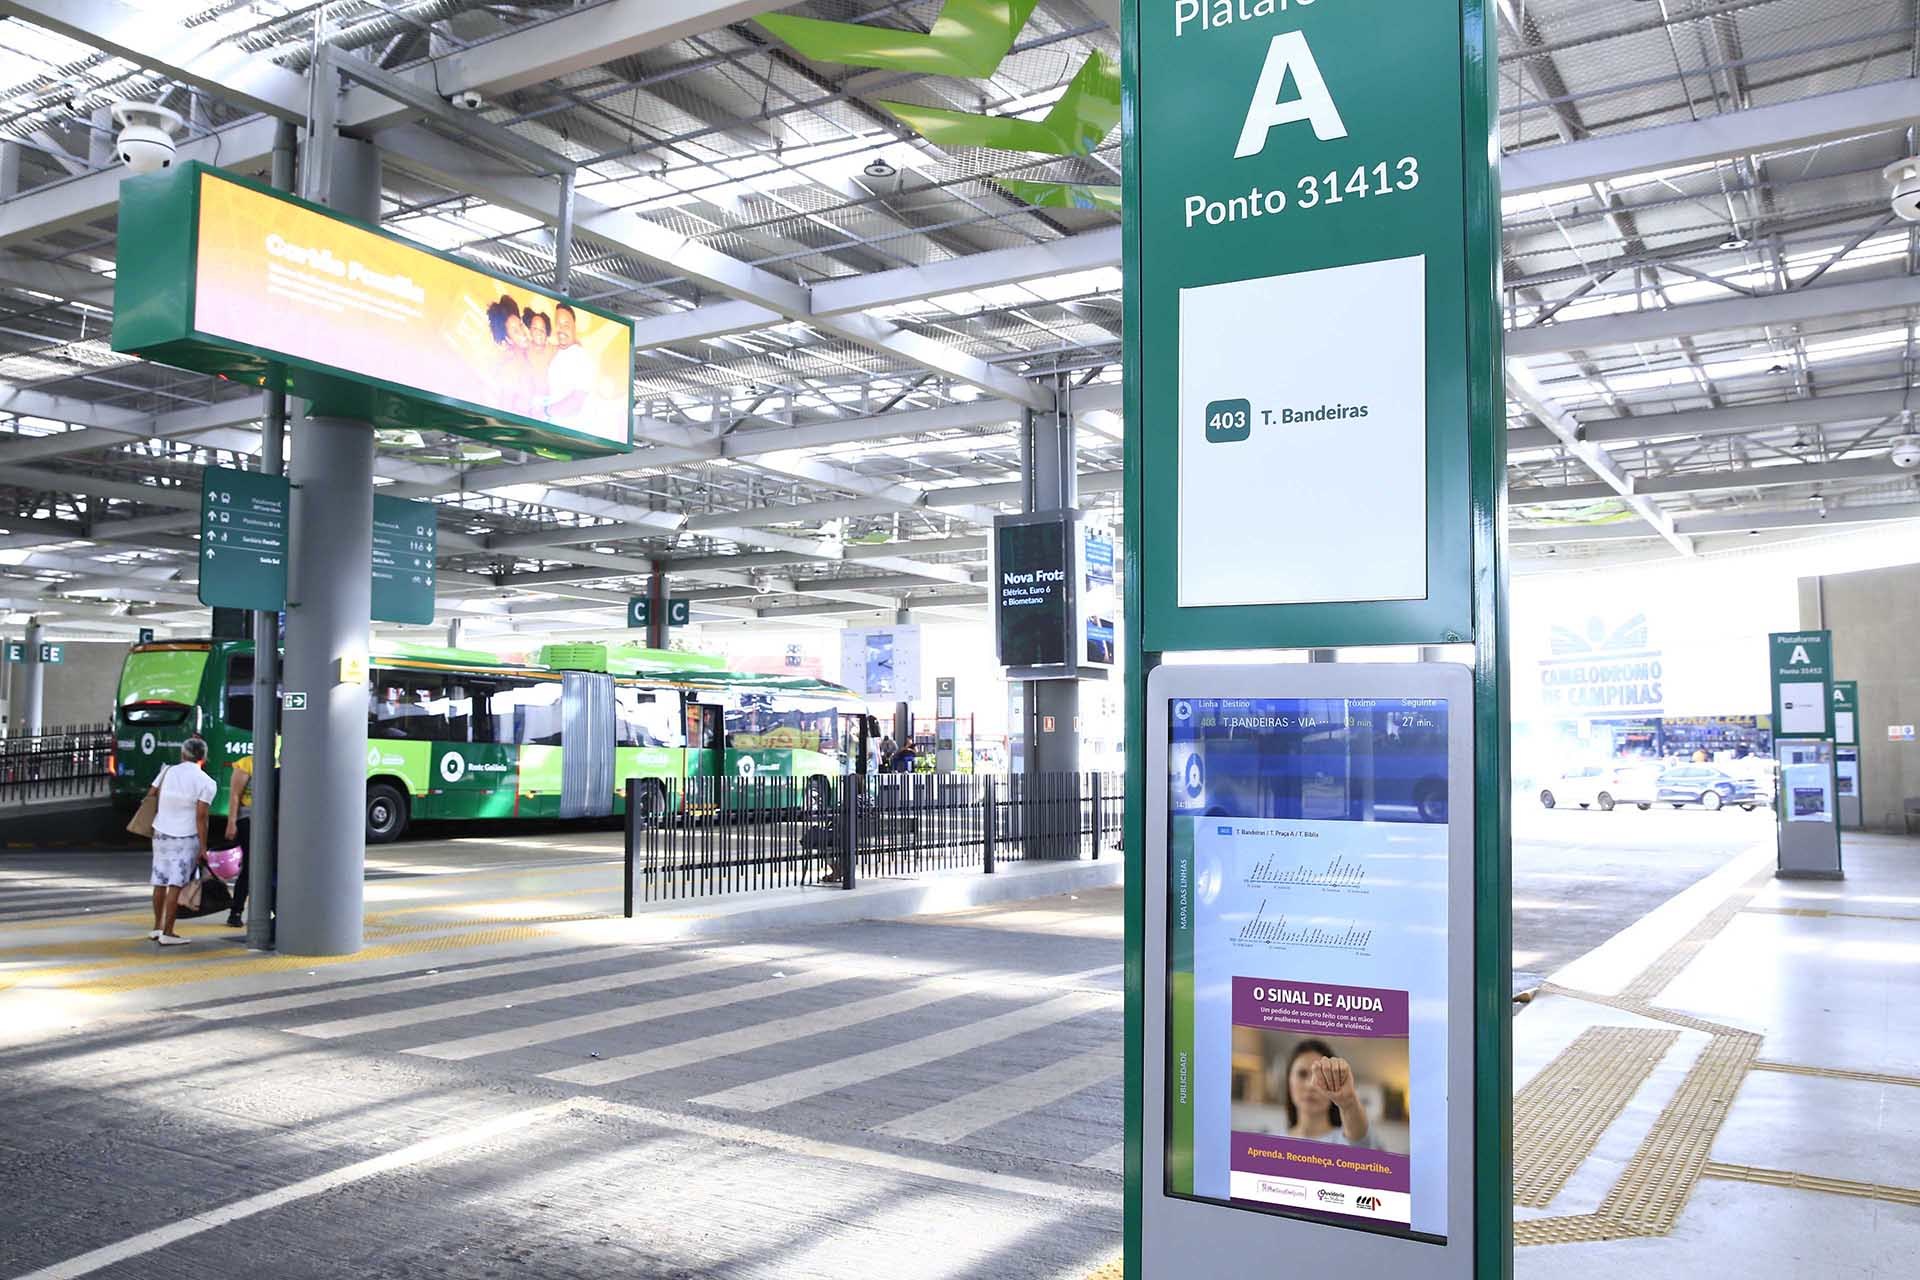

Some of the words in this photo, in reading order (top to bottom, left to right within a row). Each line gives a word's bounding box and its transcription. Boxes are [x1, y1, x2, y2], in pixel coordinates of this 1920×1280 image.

[1175, 0, 1317, 36] Plata
[1233, 29, 1348, 159] A
[1184, 187, 1287, 228] Ponto
[1297, 156, 1419, 209] 31413
[1209, 411, 1246, 430] 403
[1261, 410, 1277, 426] T.
[1282, 404, 1369, 424] Bandeiras
[1004, 572, 1033, 584] Nova
[1036, 569, 1064, 582] Frota
[1030, 587, 1045, 595] Euro
[1008, 597, 1043, 606] Biometano
[634, 602, 646, 620] C
[672, 603, 685, 621] C
[10, 646, 20, 660] E
[42, 646, 49, 660] E
[50, 647, 60, 661] E
[1789, 645, 1811, 664] A
[942, 682, 949, 690] C
[1833, 689, 1845, 701] A
[1199, 700, 1218, 708] Linha
[1222, 700, 1250, 708] Destino
[1223, 717, 1289, 728] T.BANDEIRAS
[1298, 718, 1317, 728] VIA
[1402, 717, 1413, 727] 27
[1180, 859, 1188, 888] LINHAS
[1180, 888, 1188, 905] DAS
[1180, 906, 1188, 929] MAPA
[1253, 986, 1265, 1001] O
[1268, 988, 1310, 1005] SINAL
[1313, 992, 1333, 1007] DE
[1335, 994, 1383, 1011] AJUDA
[1271, 1007, 1291, 1015] pedido
[1322, 1011, 1335, 1019] feito
[1311, 1019, 1335, 1028] situação
[1344, 1021, 1373, 1031] violência.
[1180, 1052, 1188, 1105] PUBLICIDADE
[1247, 1147, 1285, 1160] Aprenda.
[1286, 1152, 1335, 1168] Reconheça.
[1336, 1158, 1393, 1174] Compartilhe.
